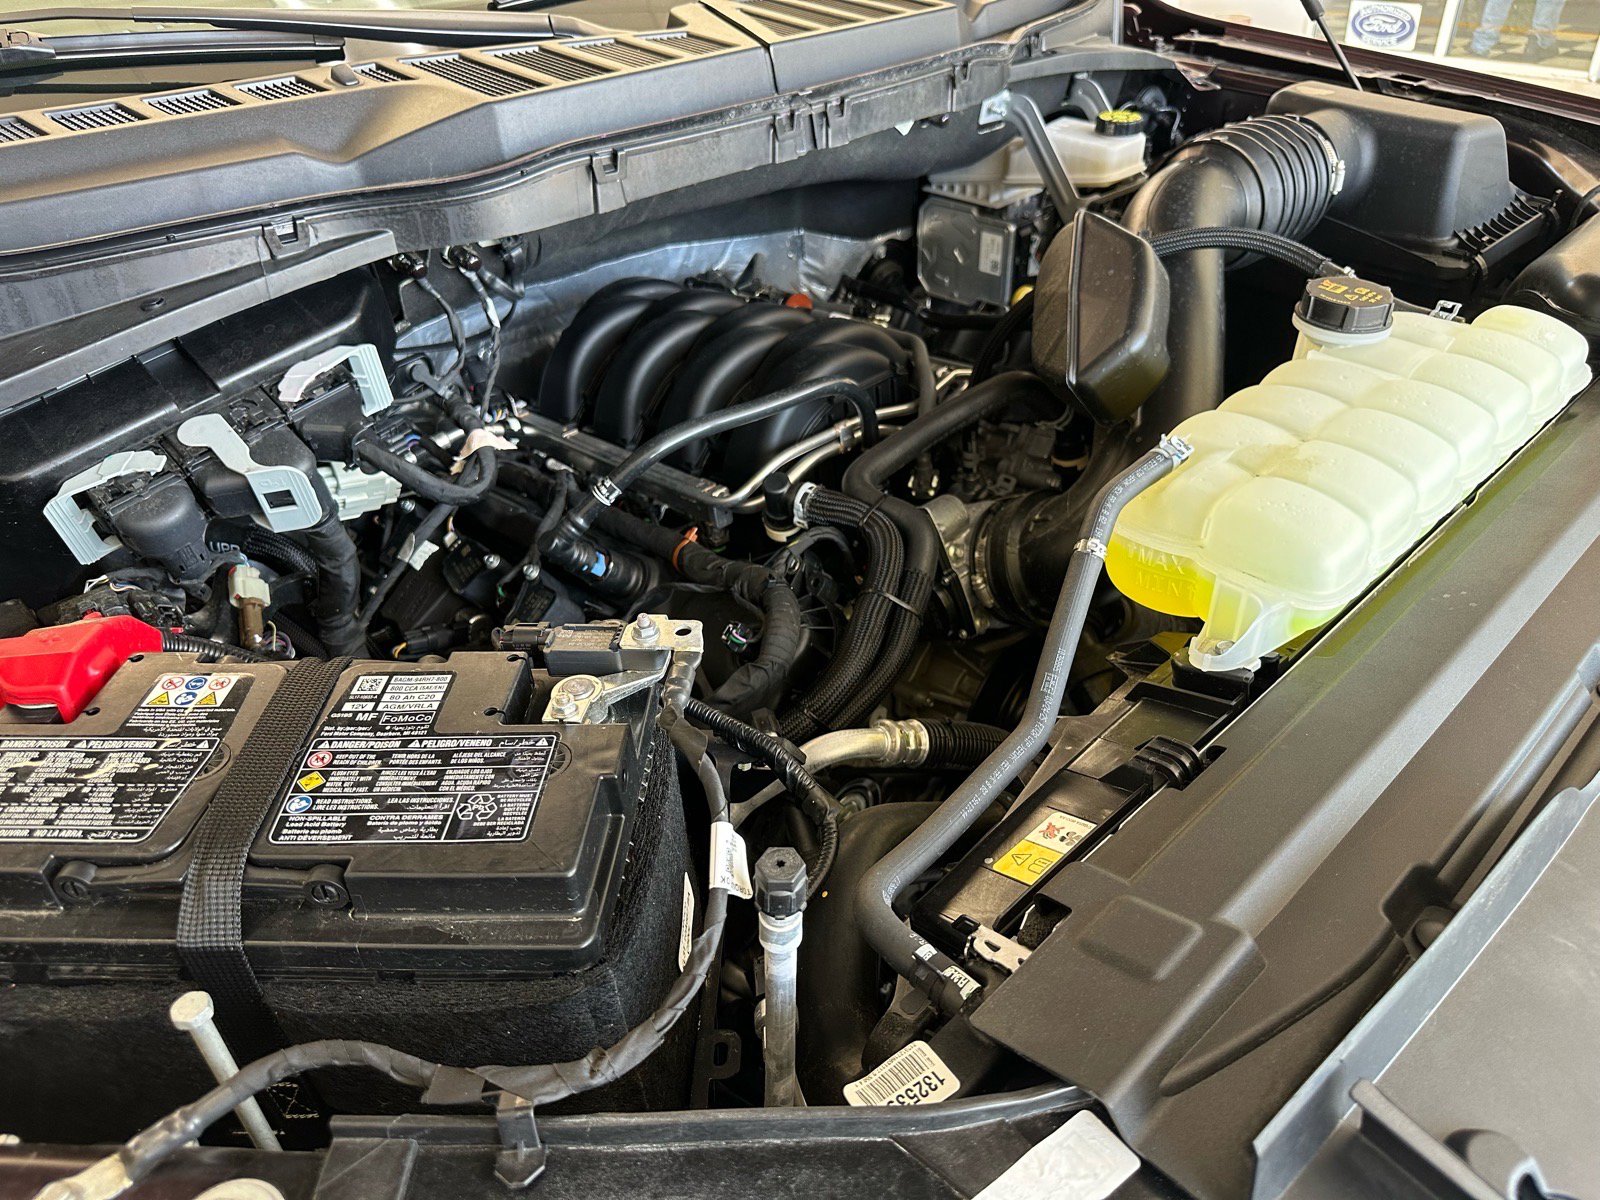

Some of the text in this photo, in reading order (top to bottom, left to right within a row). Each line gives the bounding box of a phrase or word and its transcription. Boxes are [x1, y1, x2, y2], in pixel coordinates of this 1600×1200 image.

[1362, 14, 1403, 33] Ford
[1137, 549, 1186, 575] MAX
[1135, 571, 1183, 597] MIN
[382, 714, 432, 723] FoMoCo
[1, 740, 71, 748] DANGER/POISON
[87, 740, 157, 748] PELIGRO/VENENO
[330, 740, 402, 749] DANGER/POISON
[420, 739, 493, 748] PELIGRO/VENENO
[47, 829, 59, 837] LA
[59, 829, 84, 837] ABRA.
[886, 1070, 946, 1107] 13253
